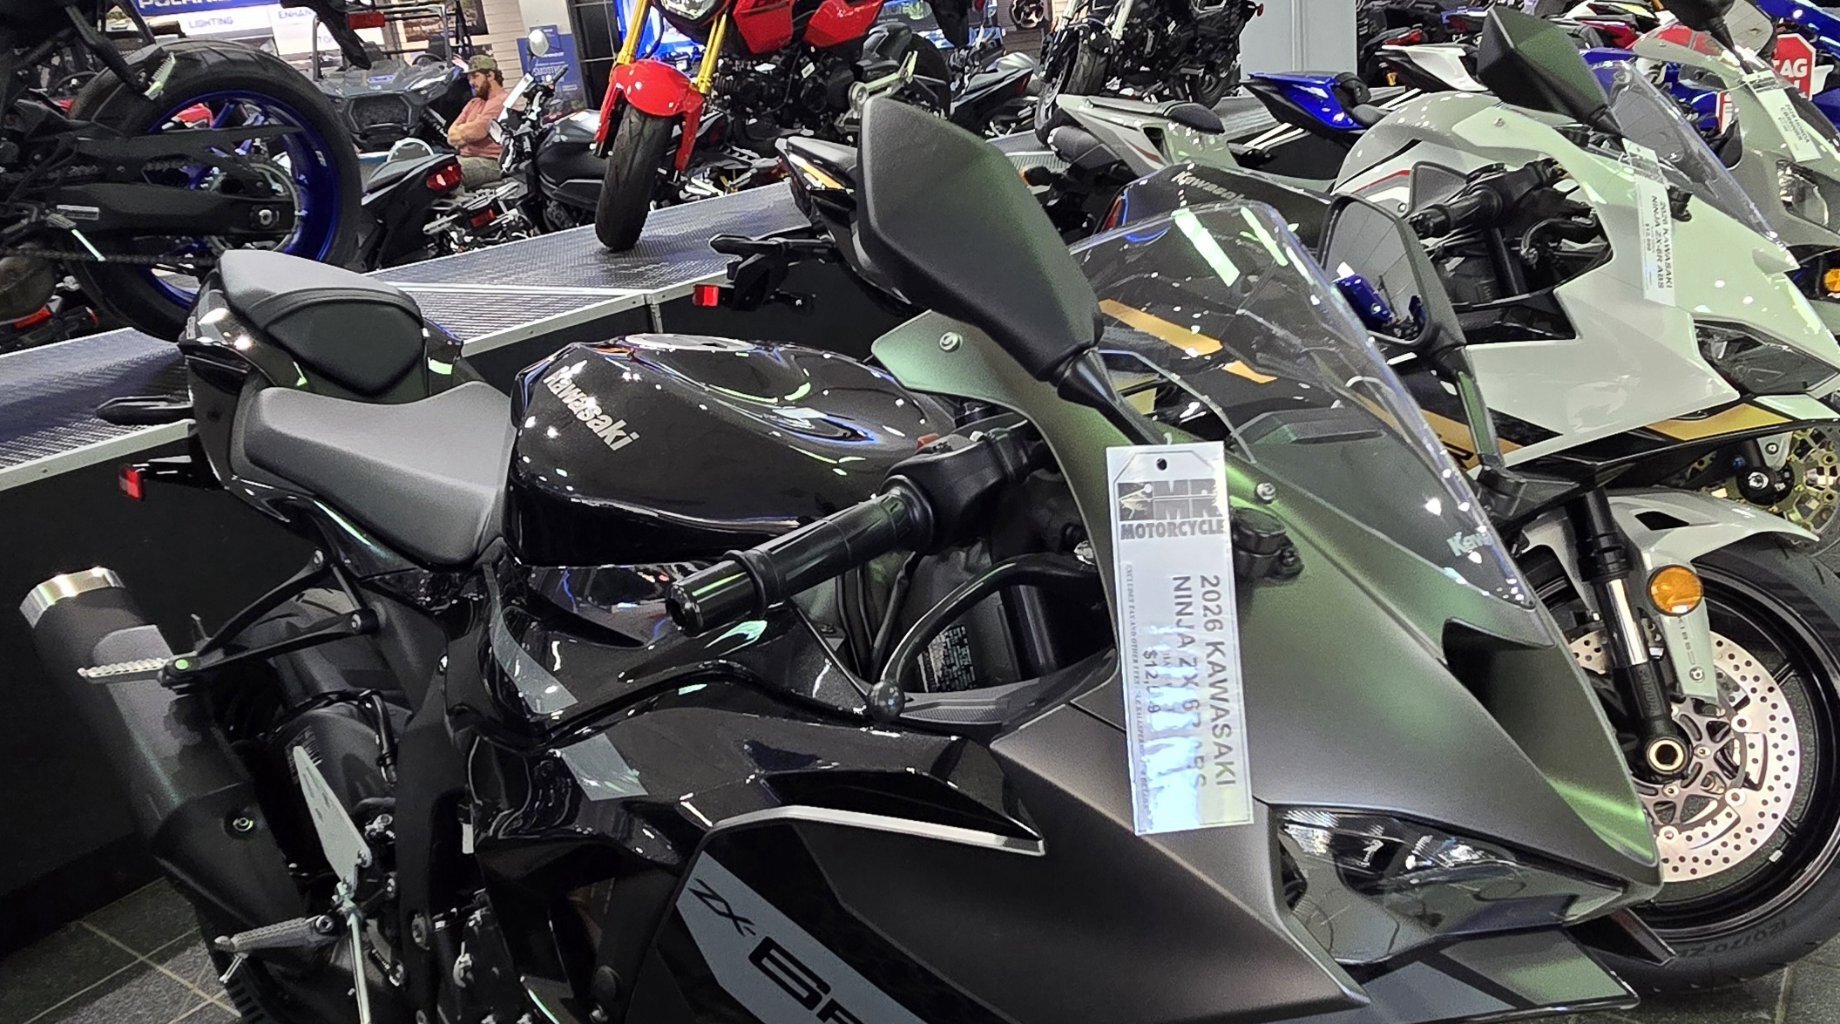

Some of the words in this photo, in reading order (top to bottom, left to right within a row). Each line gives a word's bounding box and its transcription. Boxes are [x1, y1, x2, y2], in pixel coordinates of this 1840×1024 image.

[1652, 195, 1661, 227] NINJA
[1663, 228, 1673, 289] KAWASAKI
[543, 360, 639, 451] Kawasaki
[1120, 518, 1226, 541] MOTORCYCLE
[1172, 576, 1196, 649] NINJA
[1200, 575, 1224, 632] 2026
[1180, 656, 1202, 729] ZX6
[1205, 641, 1236, 786] KAWASAKI
